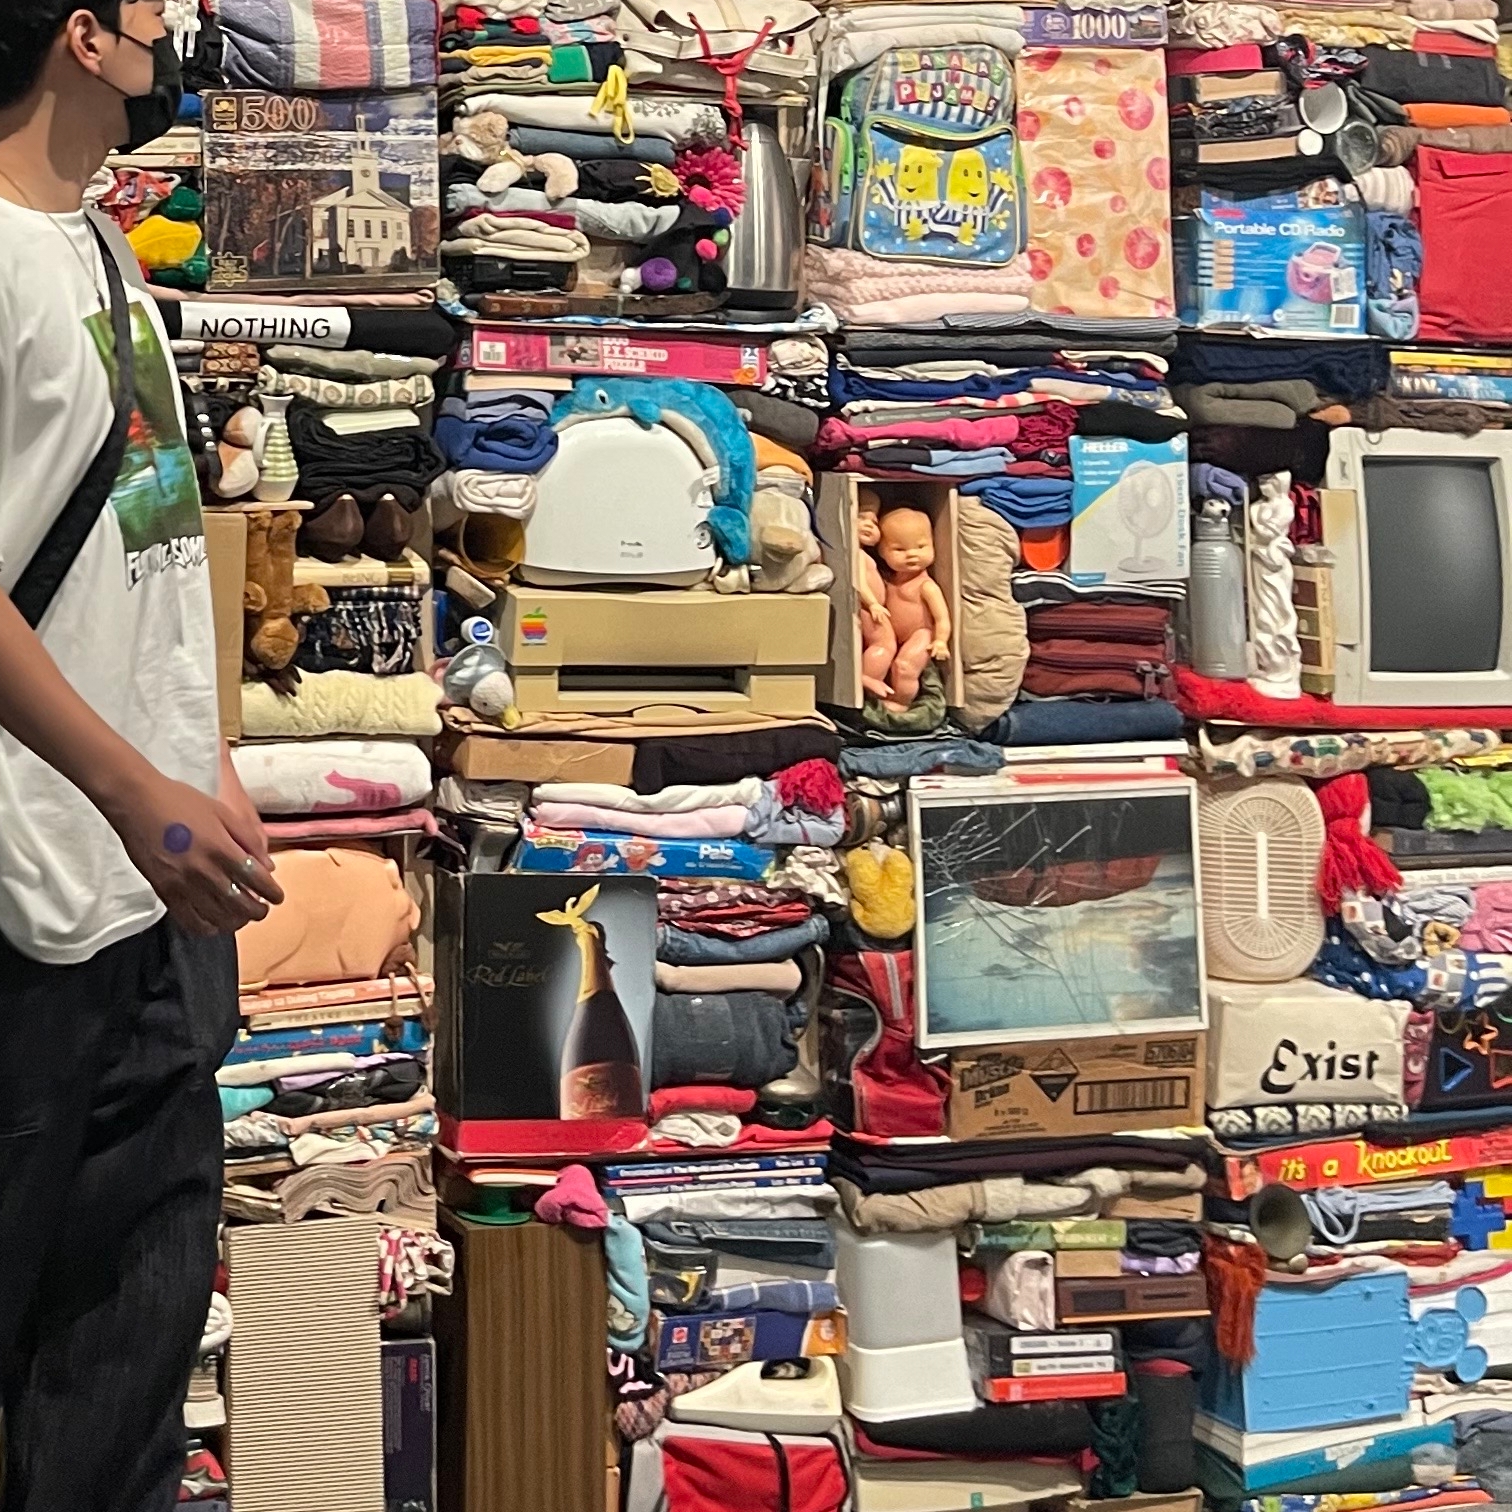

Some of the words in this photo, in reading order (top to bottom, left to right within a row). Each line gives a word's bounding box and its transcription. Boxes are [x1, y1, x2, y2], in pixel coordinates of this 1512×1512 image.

[1071, 13, 1127, 40] 1000
[241, 94, 317, 131] 500
[1213, 220, 1277, 236] Portable
[1279, 223, 1300, 237] CD
[1303, 224, 1346, 238] Radio
[199, 317, 331, 339] NOTHING
[1260, 1038, 1380, 1095] Exist
[1322, 1159, 1339, 1178] a
[1354, 1139, 1454, 1179] knockout
